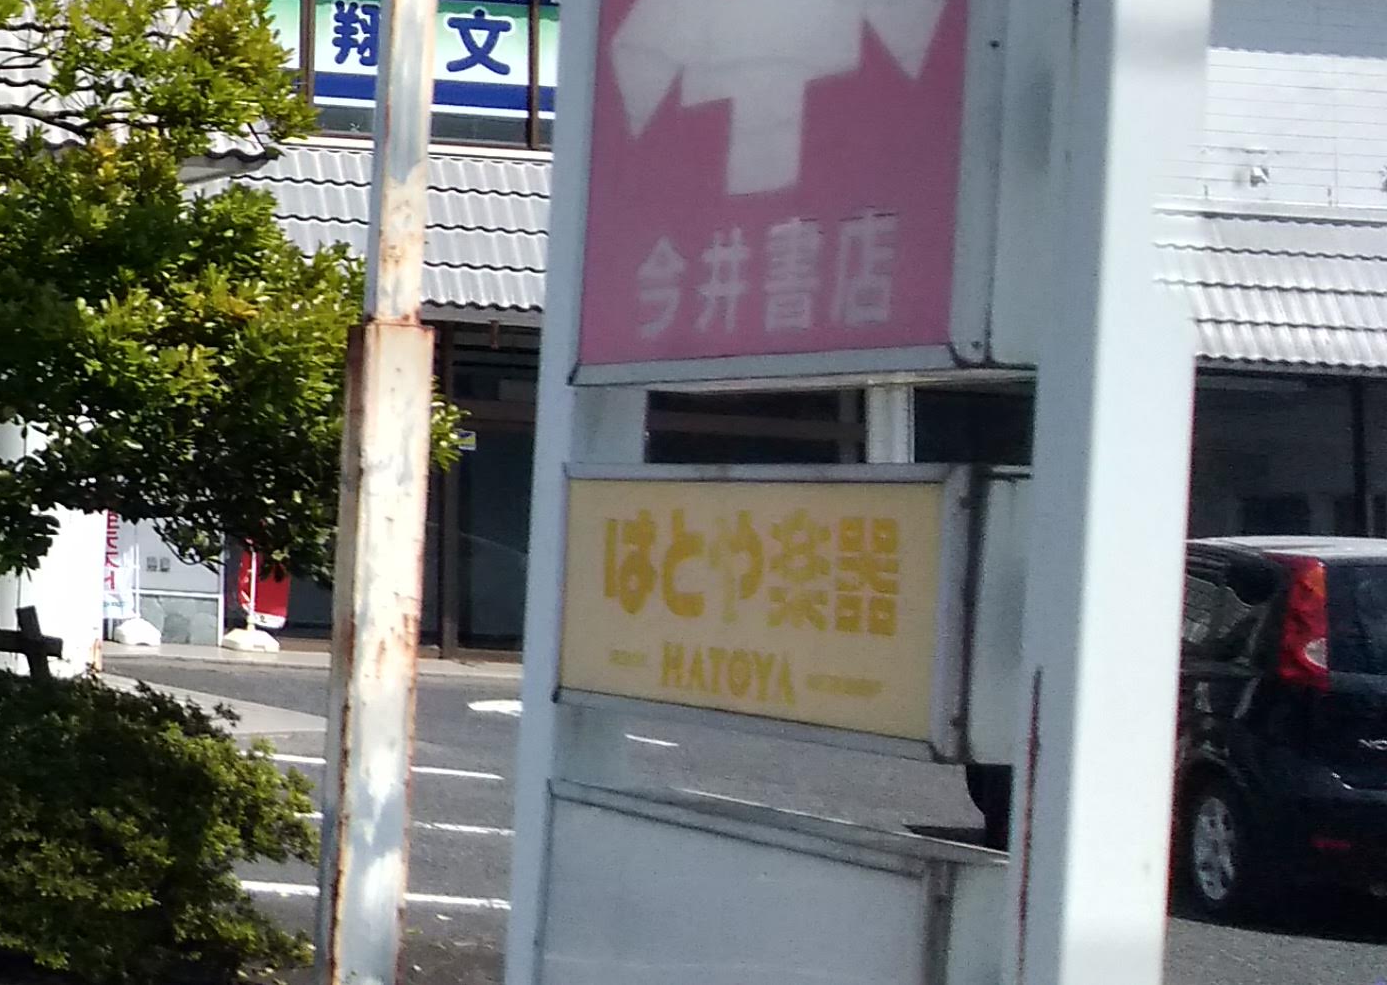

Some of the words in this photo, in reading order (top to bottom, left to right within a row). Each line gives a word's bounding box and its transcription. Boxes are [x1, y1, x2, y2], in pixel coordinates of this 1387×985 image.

[638, 206, 899, 339] 今井書店
[604, 509, 899, 636] はとや楽器
[661, 641, 796, 706] HATOYA
